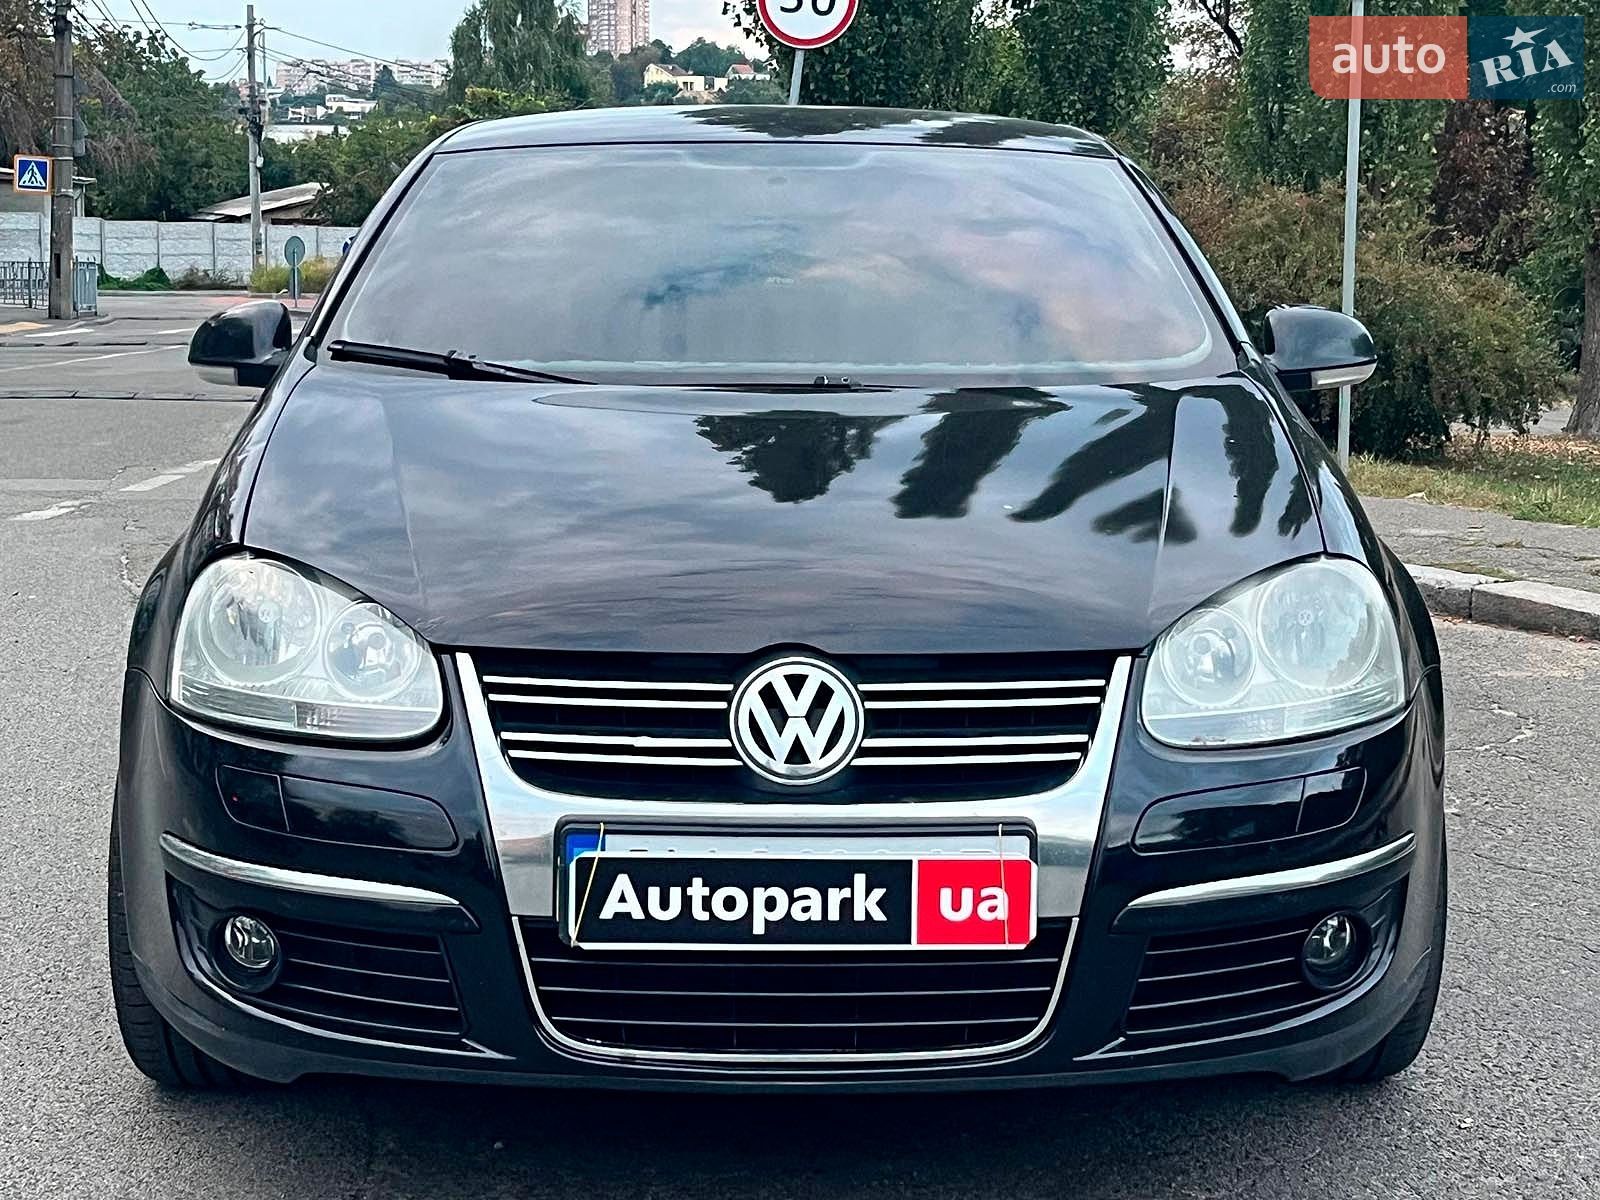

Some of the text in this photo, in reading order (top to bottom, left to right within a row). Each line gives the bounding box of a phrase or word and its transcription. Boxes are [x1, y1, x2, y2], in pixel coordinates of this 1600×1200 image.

[737, 664, 856, 777] VW
[599, 873, 1009, 935] Autopark ua
